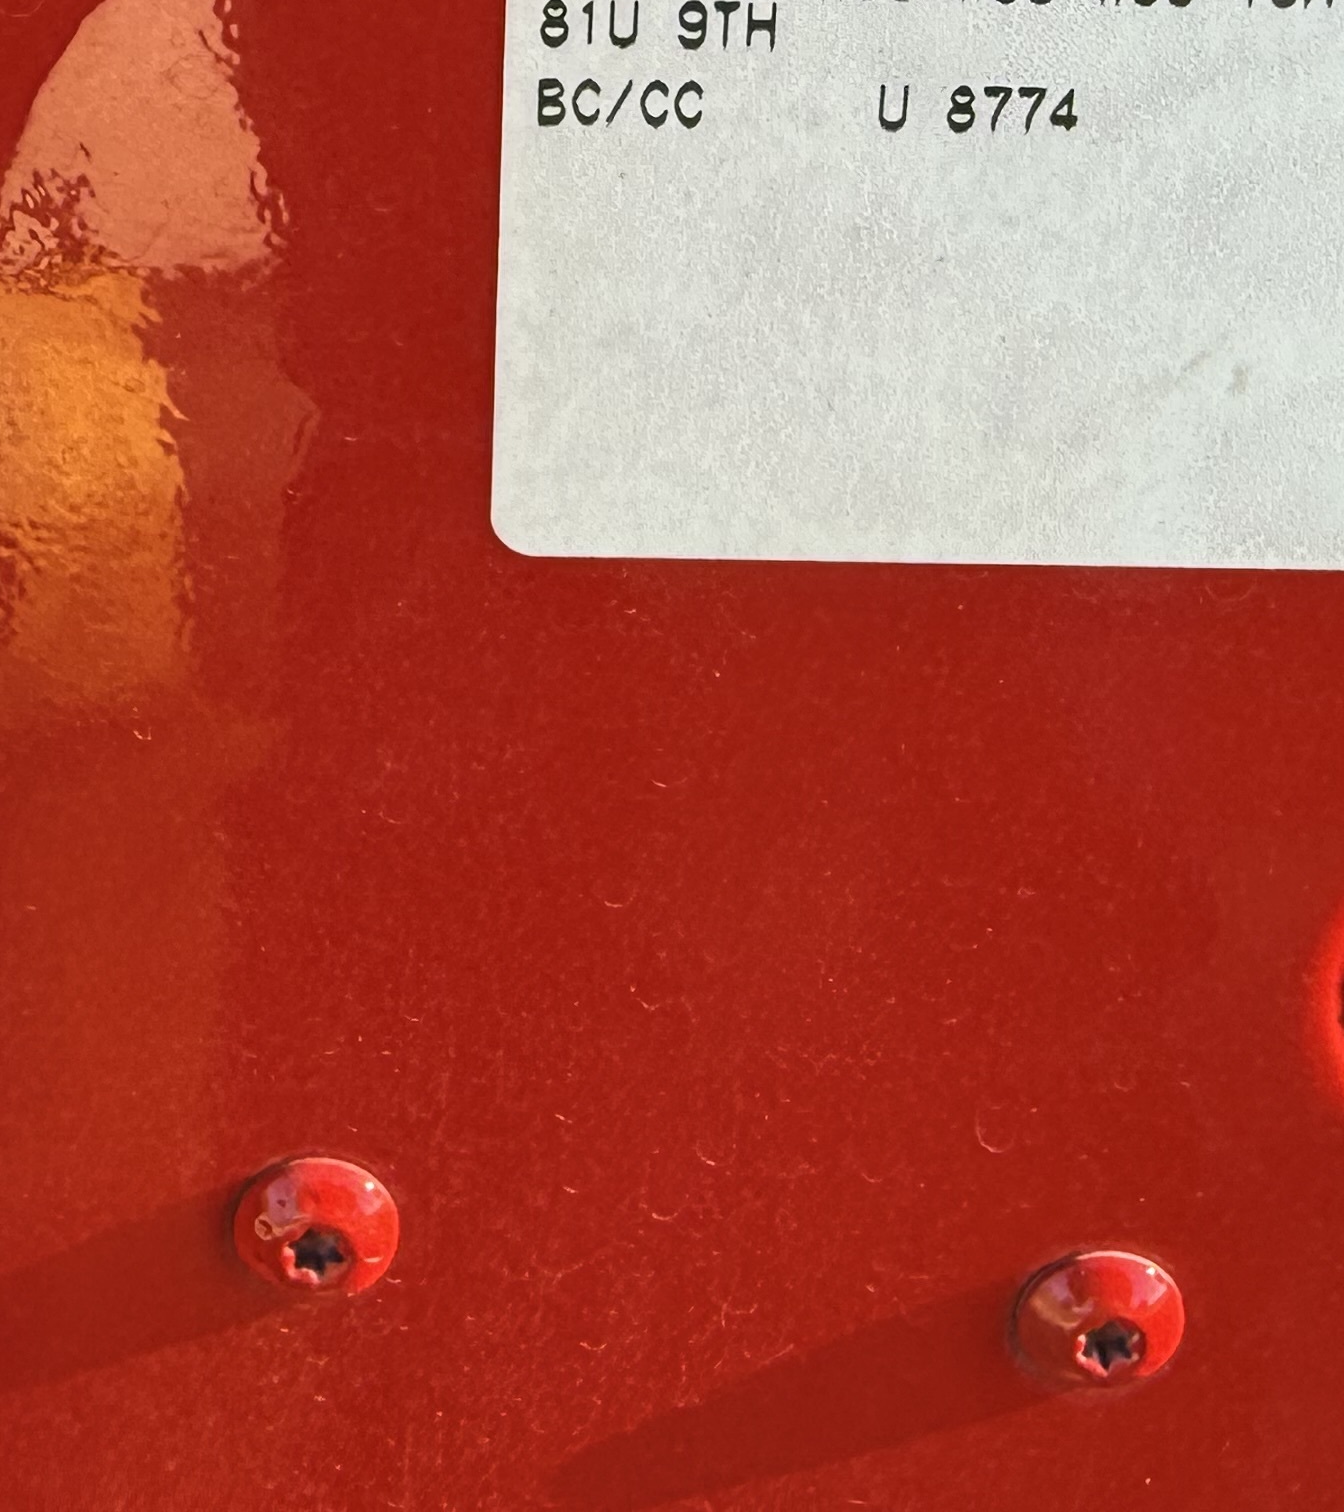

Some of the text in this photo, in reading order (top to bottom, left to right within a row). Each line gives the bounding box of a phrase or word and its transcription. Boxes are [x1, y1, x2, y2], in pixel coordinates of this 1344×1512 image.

[678, 1, 776, 51] 9TH
[538, 79, 703, 128] BC/CC
[879, 85, 909, 132] U
[947, 86, 1077, 133] 8774
